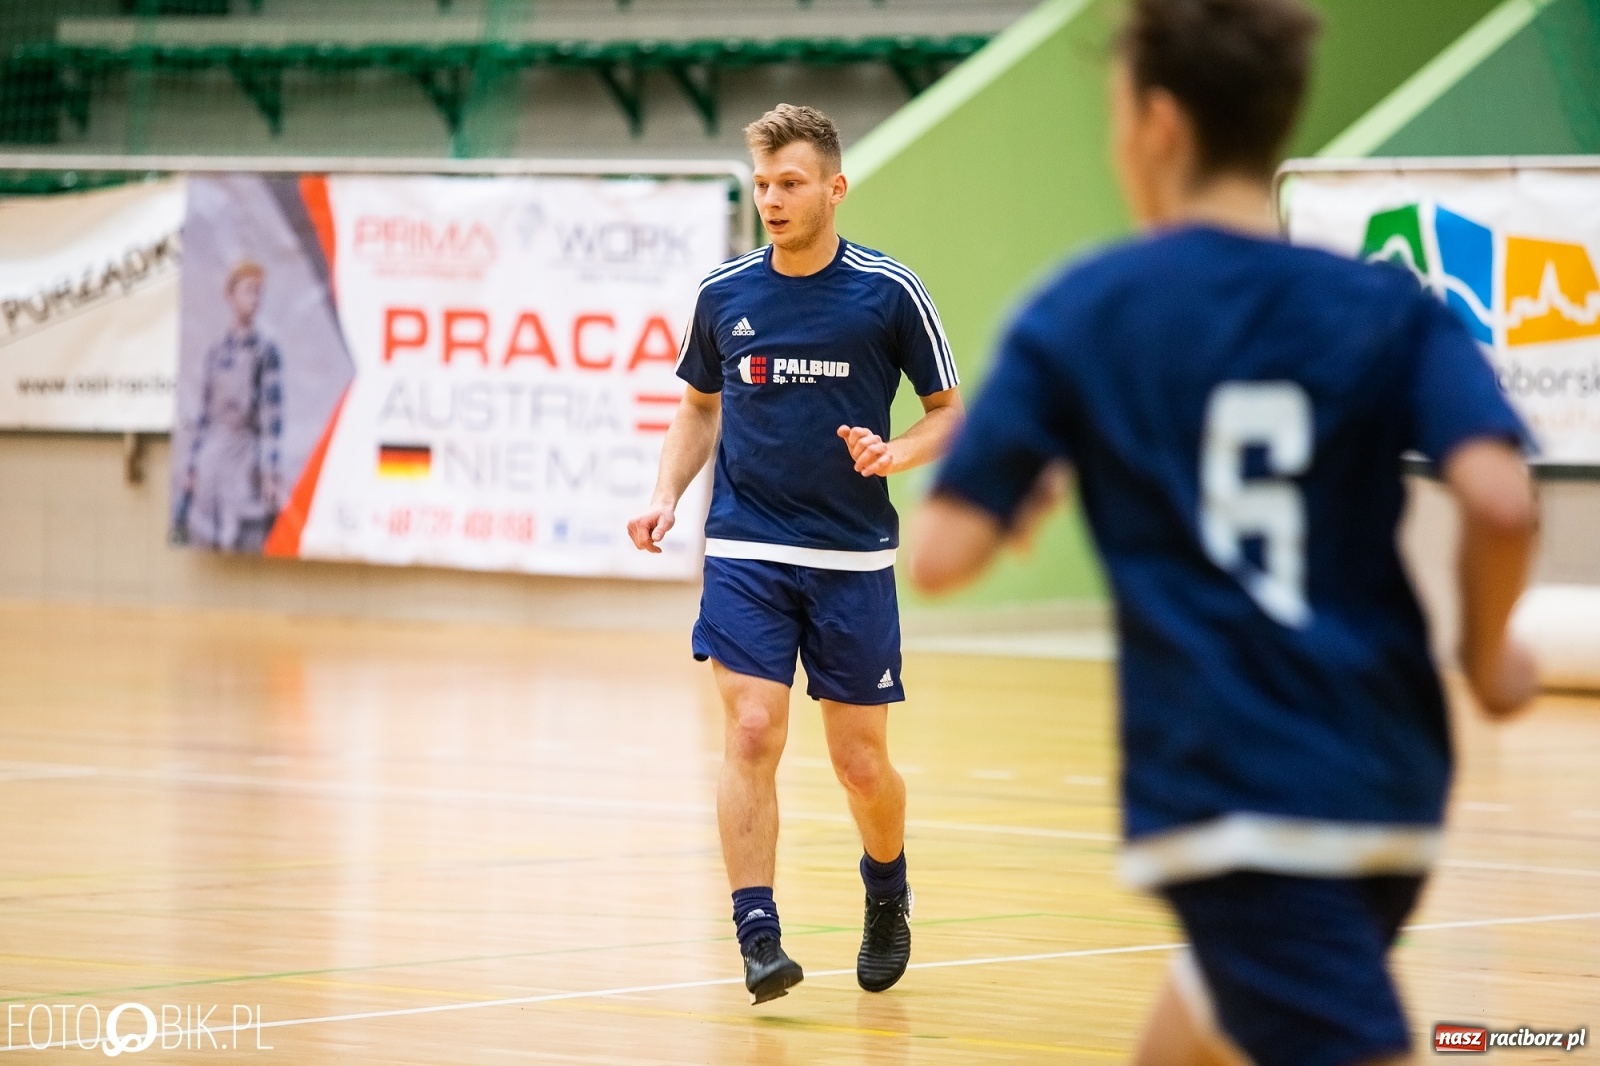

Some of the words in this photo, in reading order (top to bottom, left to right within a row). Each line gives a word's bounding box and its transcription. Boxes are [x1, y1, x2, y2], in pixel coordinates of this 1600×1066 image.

[353, 214, 499, 259] PRIMA
[555, 221, 696, 264] WORK
[381, 307, 679, 373] PRACA
[773, 358, 850, 378] PALBUD
[773, 374, 789, 385] Sp.
[800, 376, 817, 384] o.o.
[378, 379, 621, 432] AUSTRIA
[443, 440, 660, 497] NIEMC
[1200, 379, 1314, 629] 6
